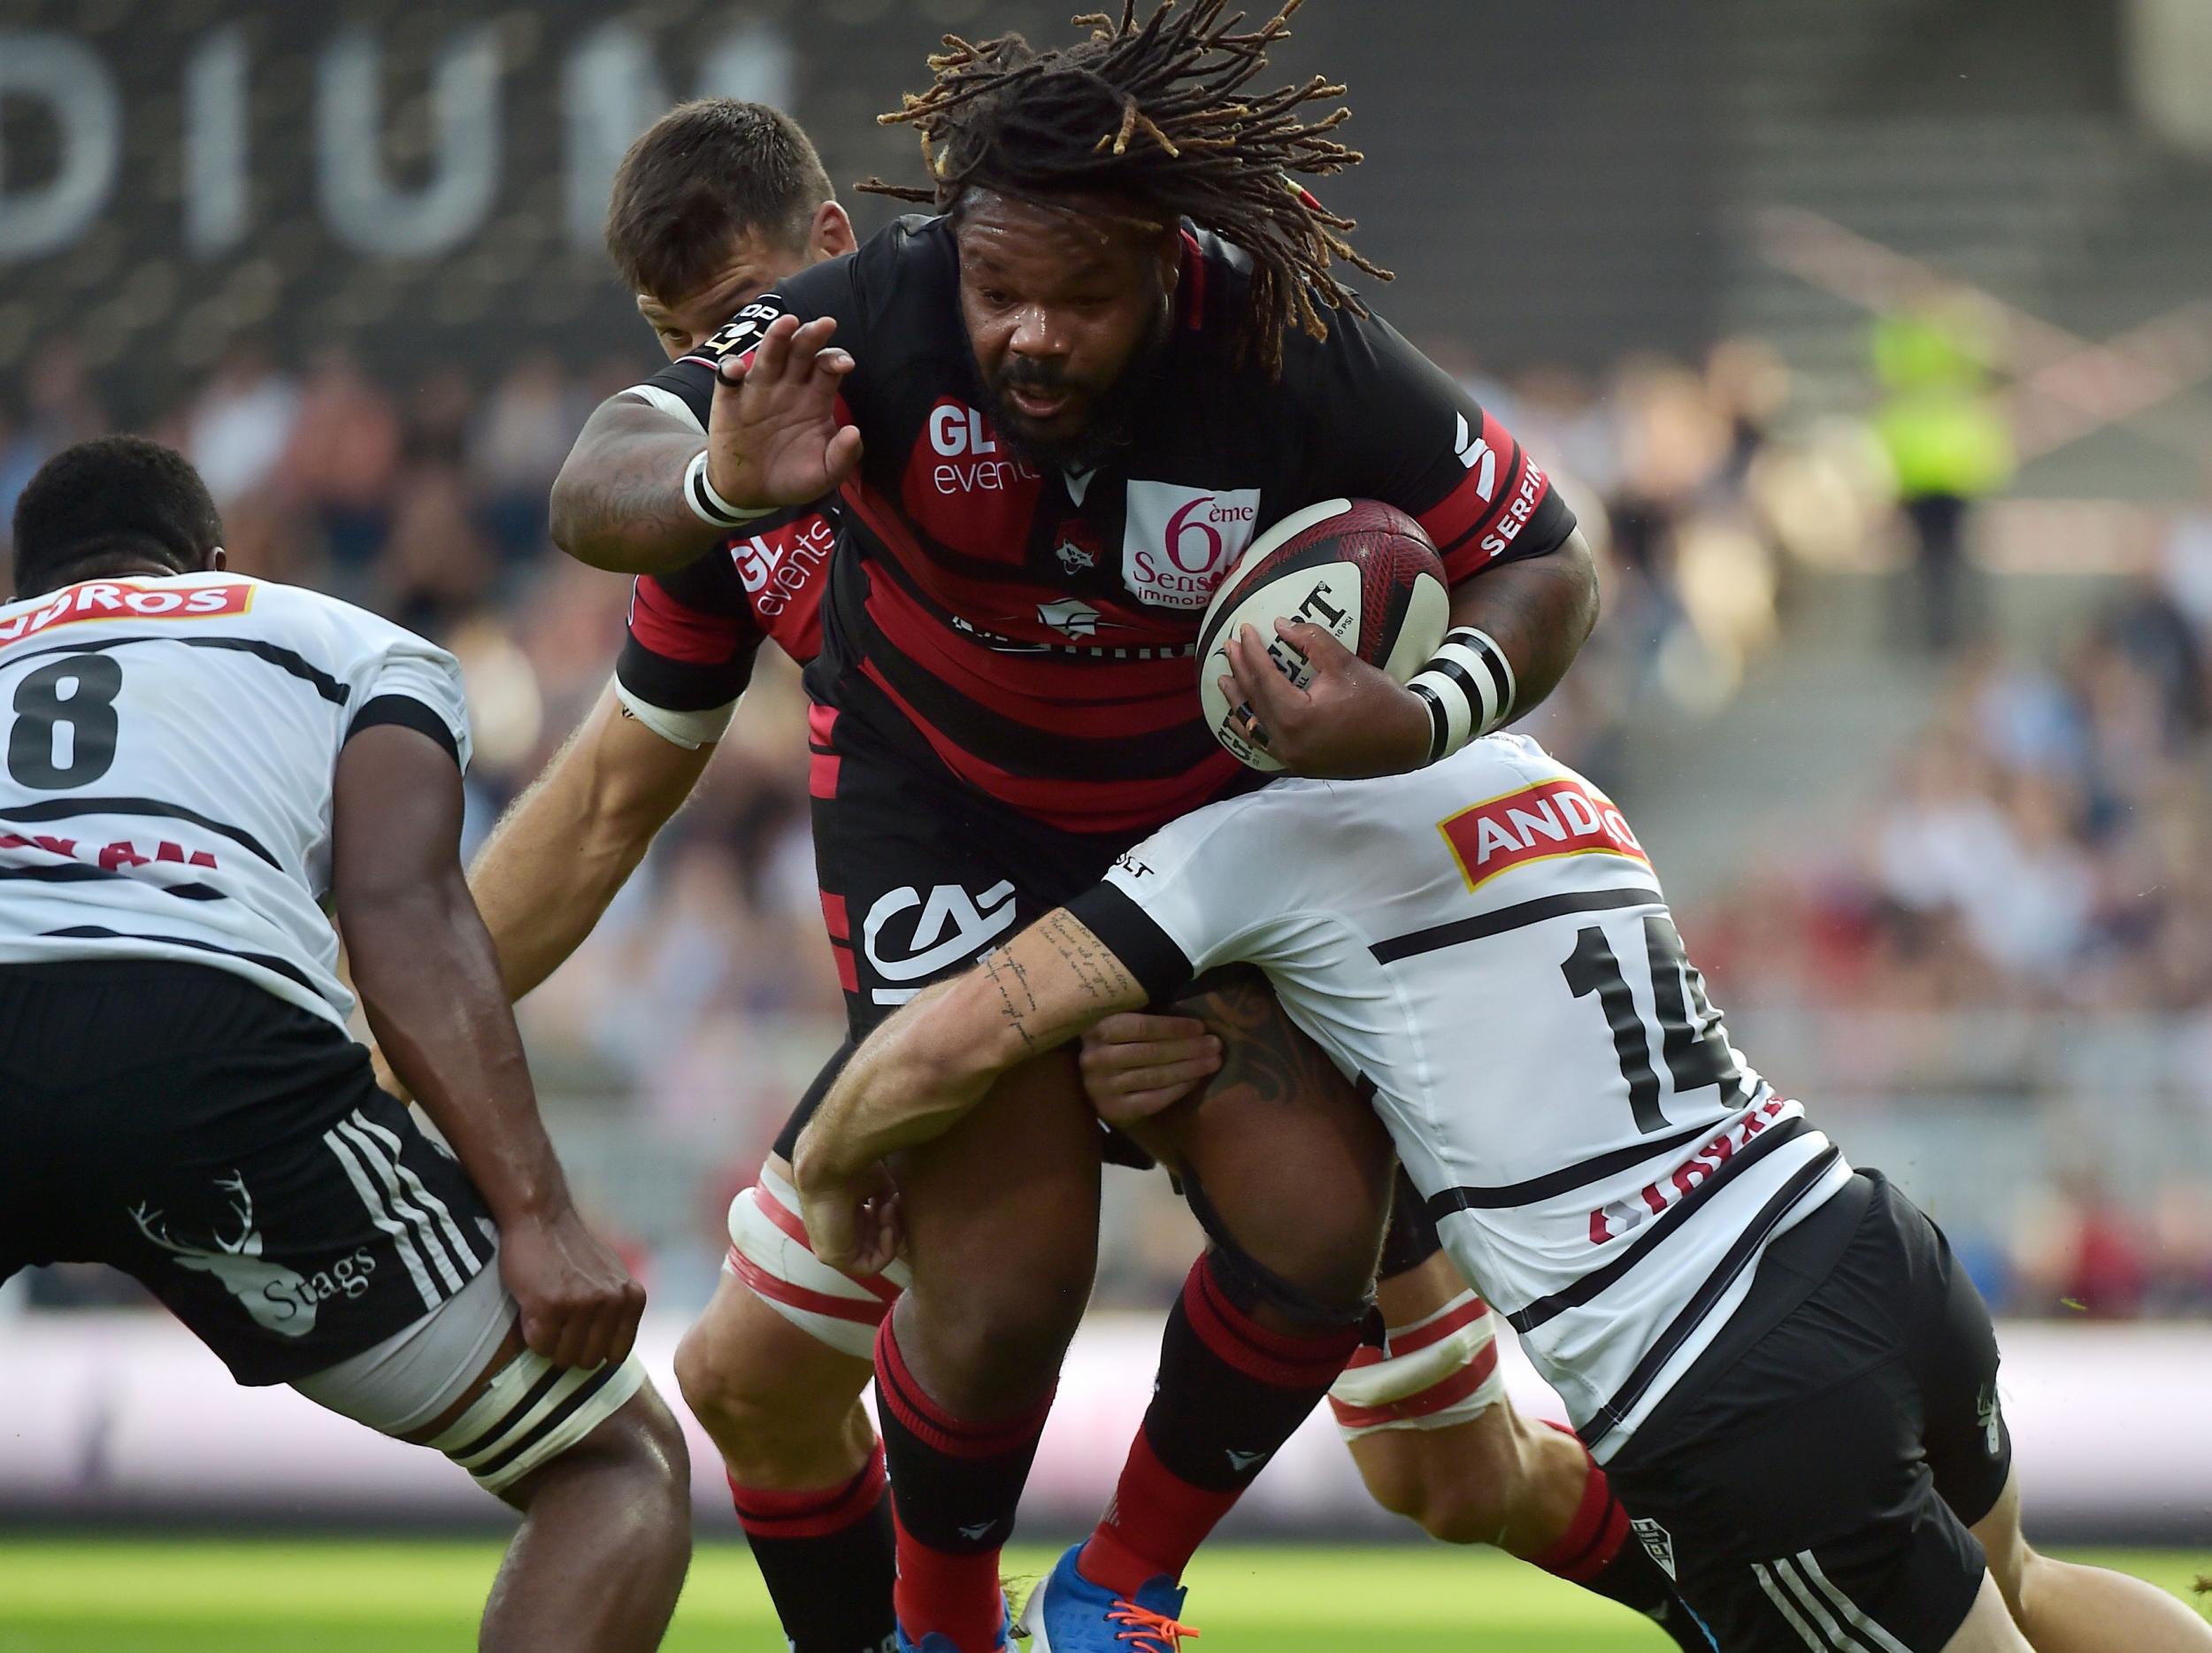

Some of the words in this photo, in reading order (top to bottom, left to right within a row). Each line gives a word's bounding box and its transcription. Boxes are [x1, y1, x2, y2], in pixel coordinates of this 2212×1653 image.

[733, 304, 780, 320] OP
[929, 404, 996, 457] GL
[730, 535, 784, 593] GL
[757, 519, 835, 616] events
[1341, 616, 1355, 630] PSI
[7, 654, 123, 789] 8
[1477, 790, 1642, 865] ANDO
[1560, 916, 1750, 1135] 14
[263, 1245, 377, 1322] Stags
